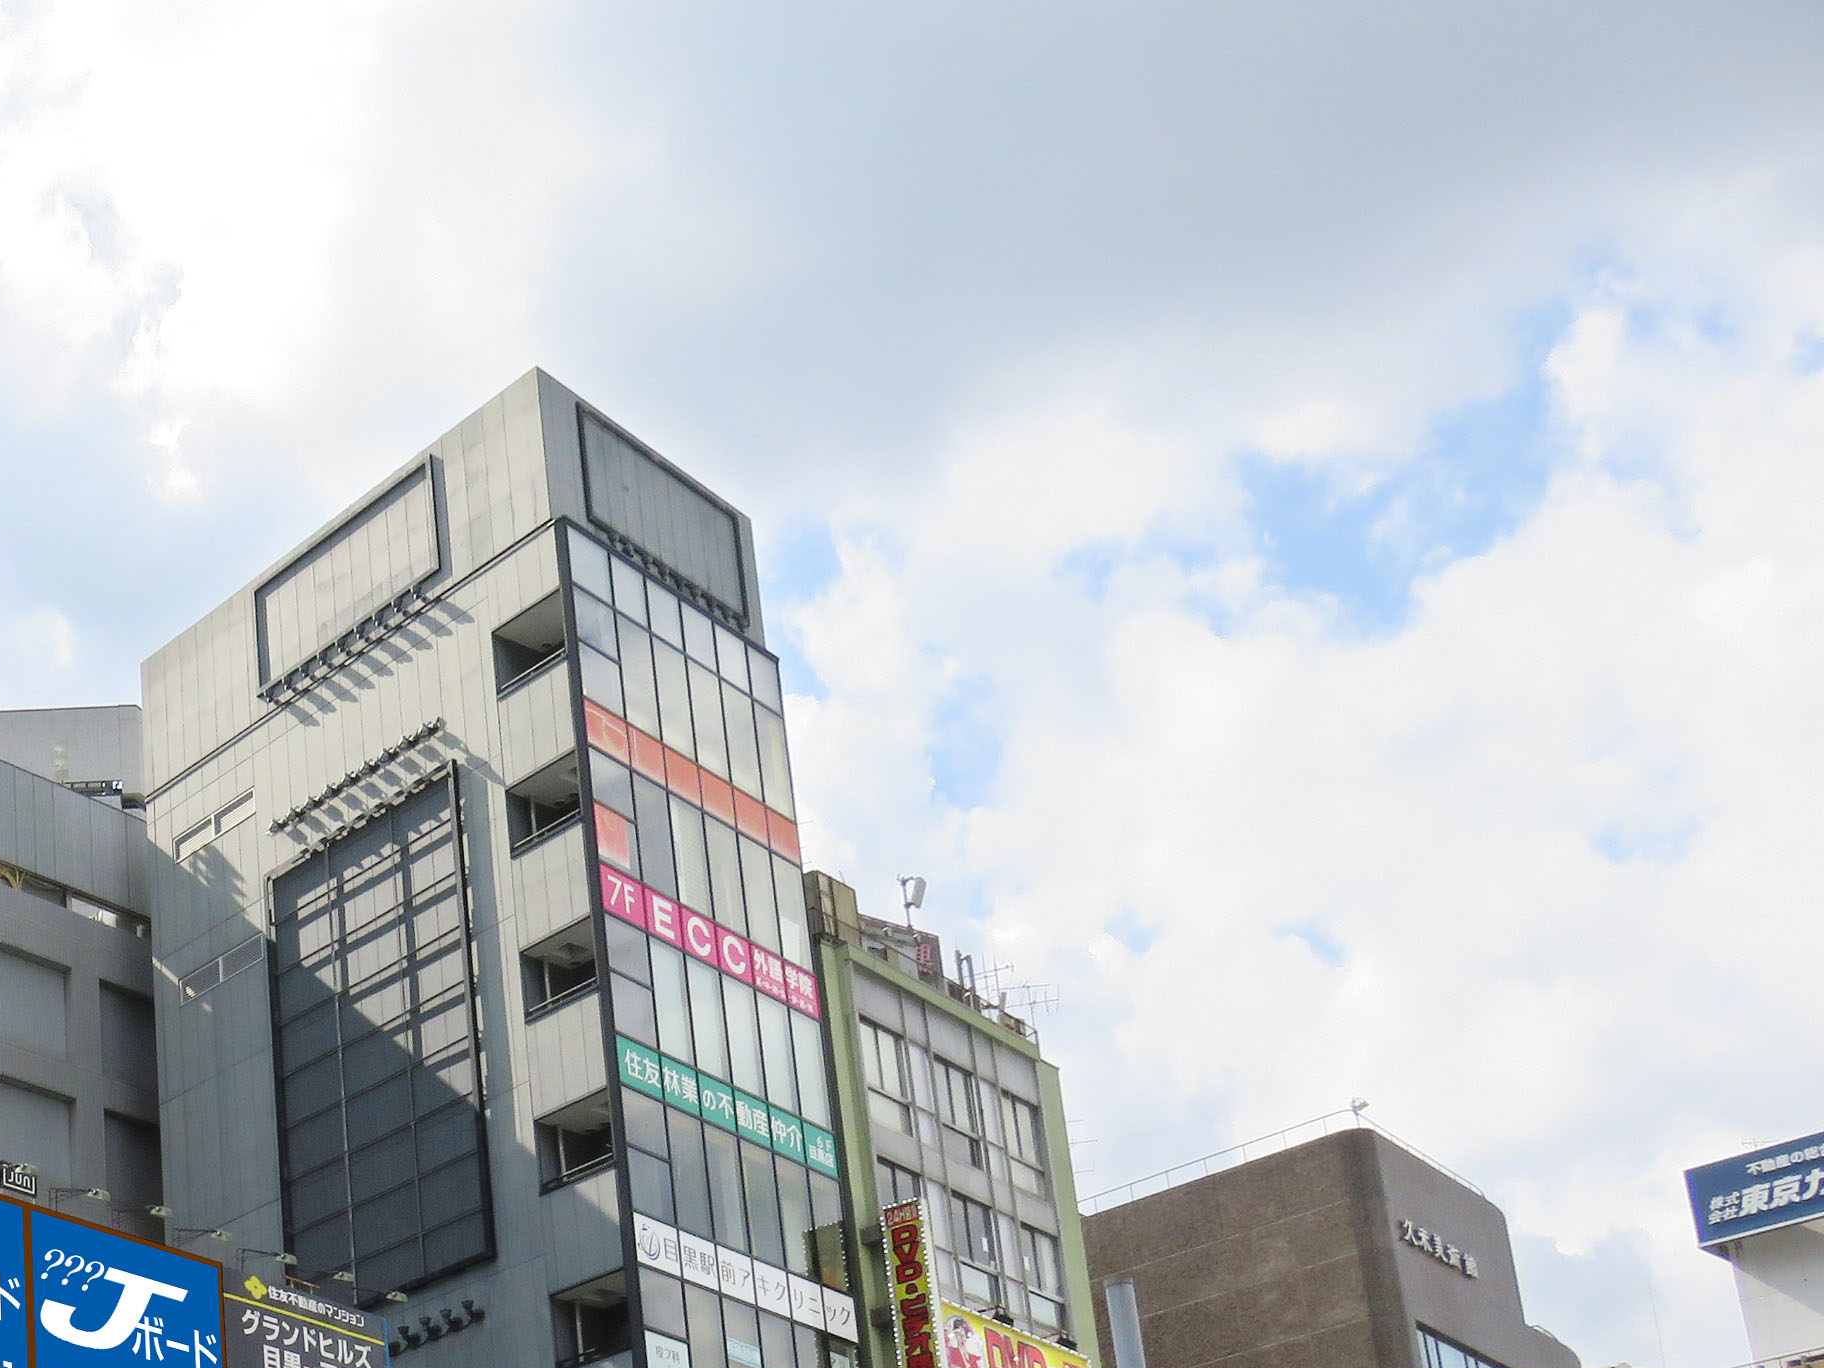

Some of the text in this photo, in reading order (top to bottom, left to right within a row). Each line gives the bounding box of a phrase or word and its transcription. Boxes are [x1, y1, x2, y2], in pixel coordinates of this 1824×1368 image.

[606, 875, 749, 976] 7F ECC
[754, 948, 814, 1000] 外語学院
[625, 1047, 803, 1154] 住友林業の不動産仲介
[268, 1286, 364, 1327] 住友不動産のマンション
[663, 1237, 851, 1326] 目黒駅前アキクリニック
